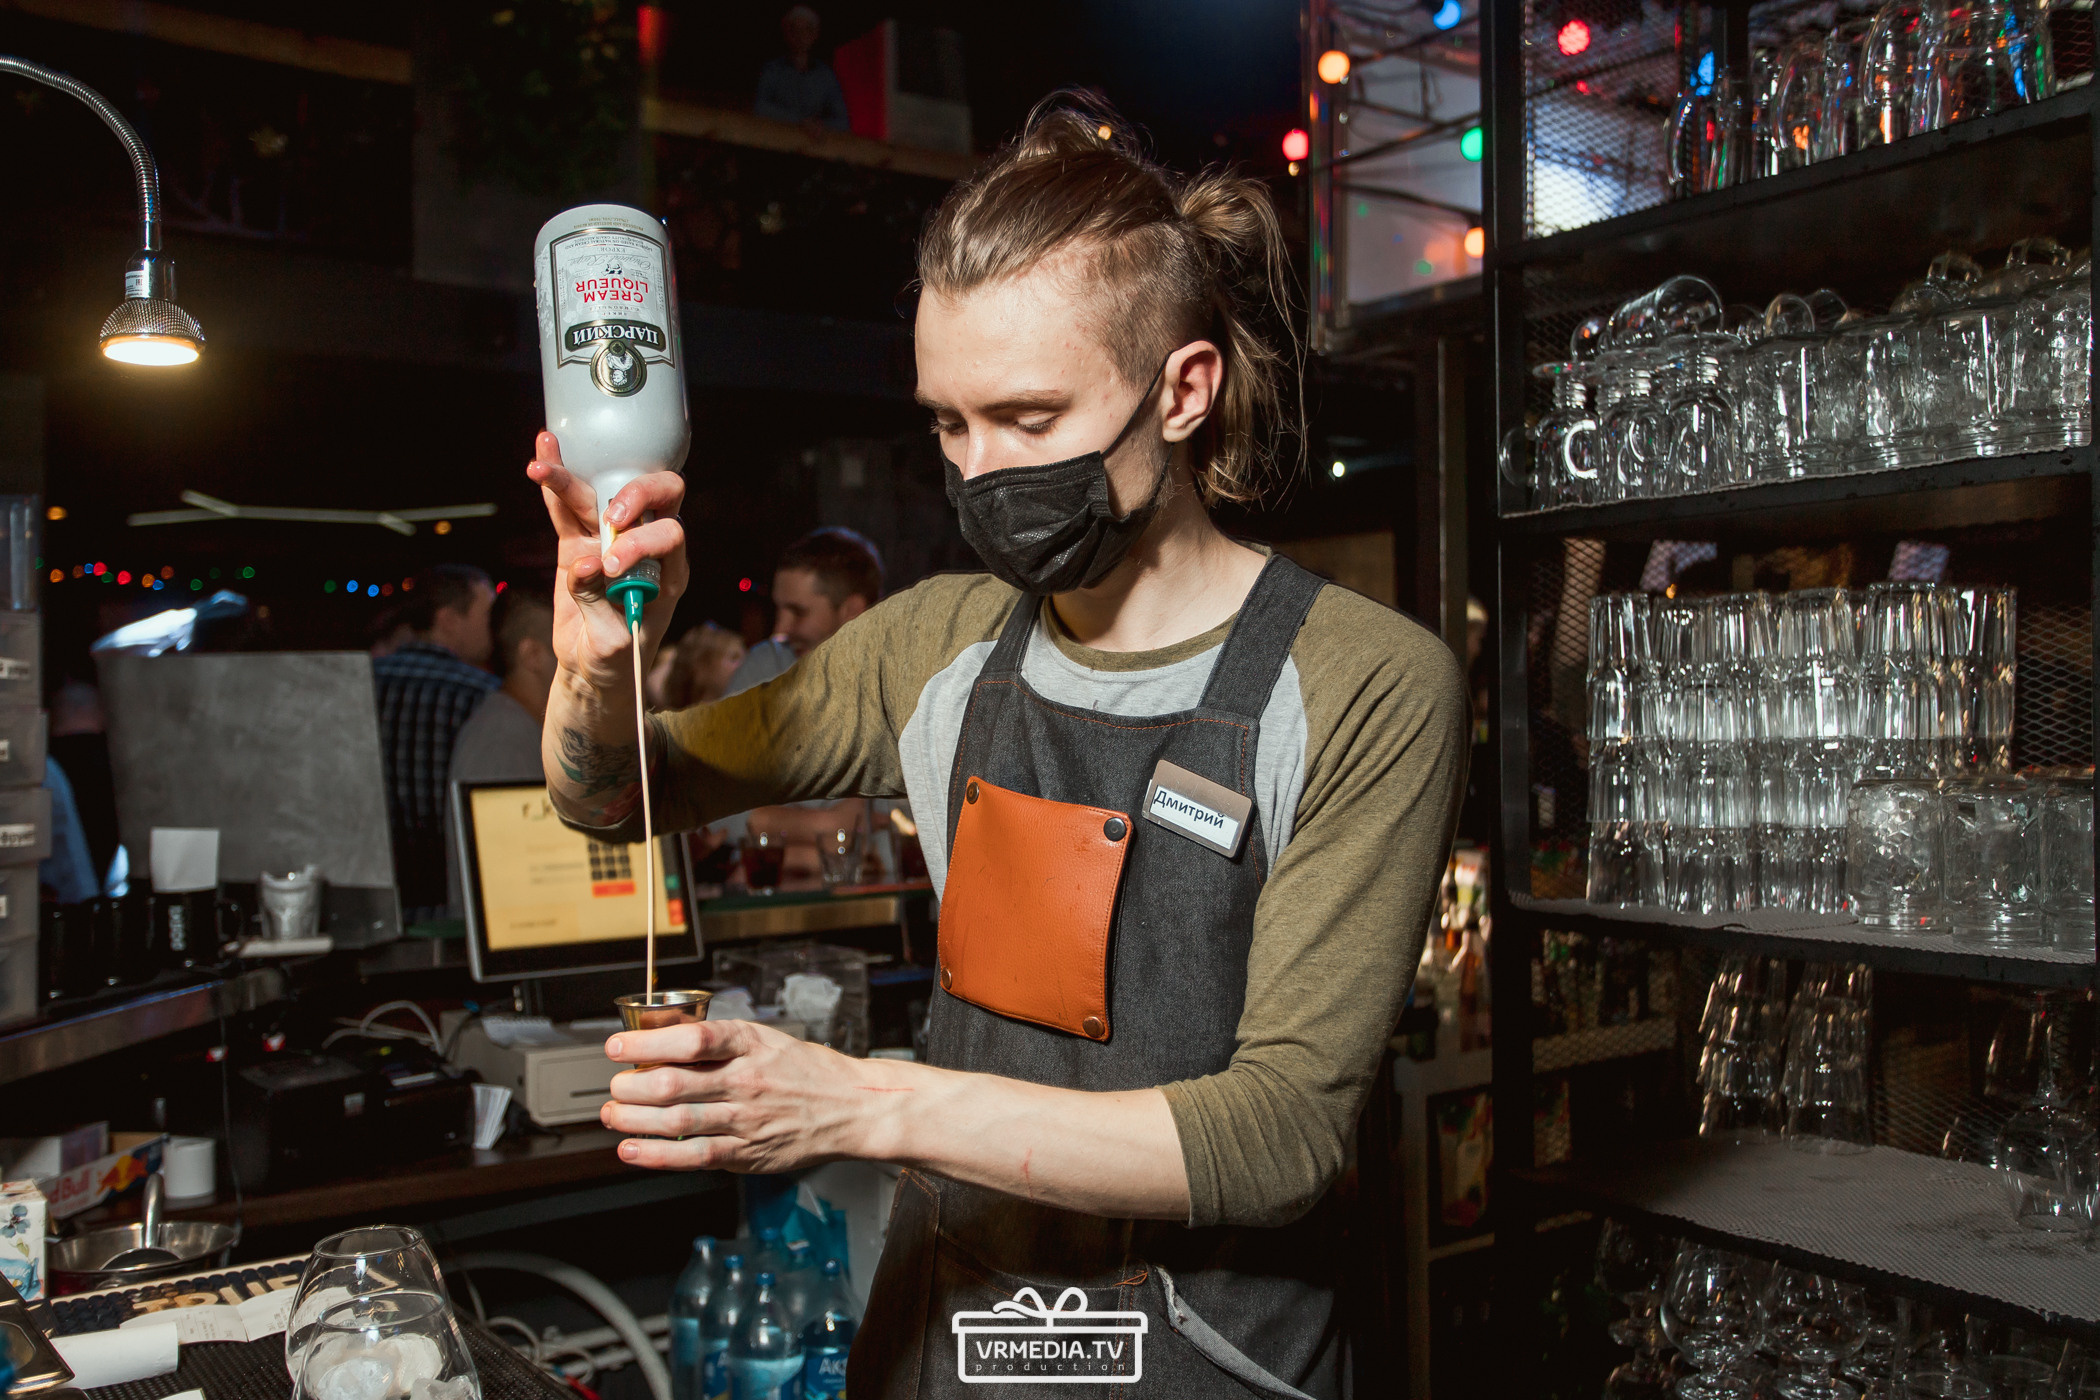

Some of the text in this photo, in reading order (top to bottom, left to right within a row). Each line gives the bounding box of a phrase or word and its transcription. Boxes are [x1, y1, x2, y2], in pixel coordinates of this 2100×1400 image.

[608, 254, 651, 270] Original
[575, 277, 649, 294] LIQUEUR
[583, 289, 644, 304] CREAM
[573, 325, 659, 346] ЦАРСКИЙ
[1153, 790, 1225, 829] Дмитрий
